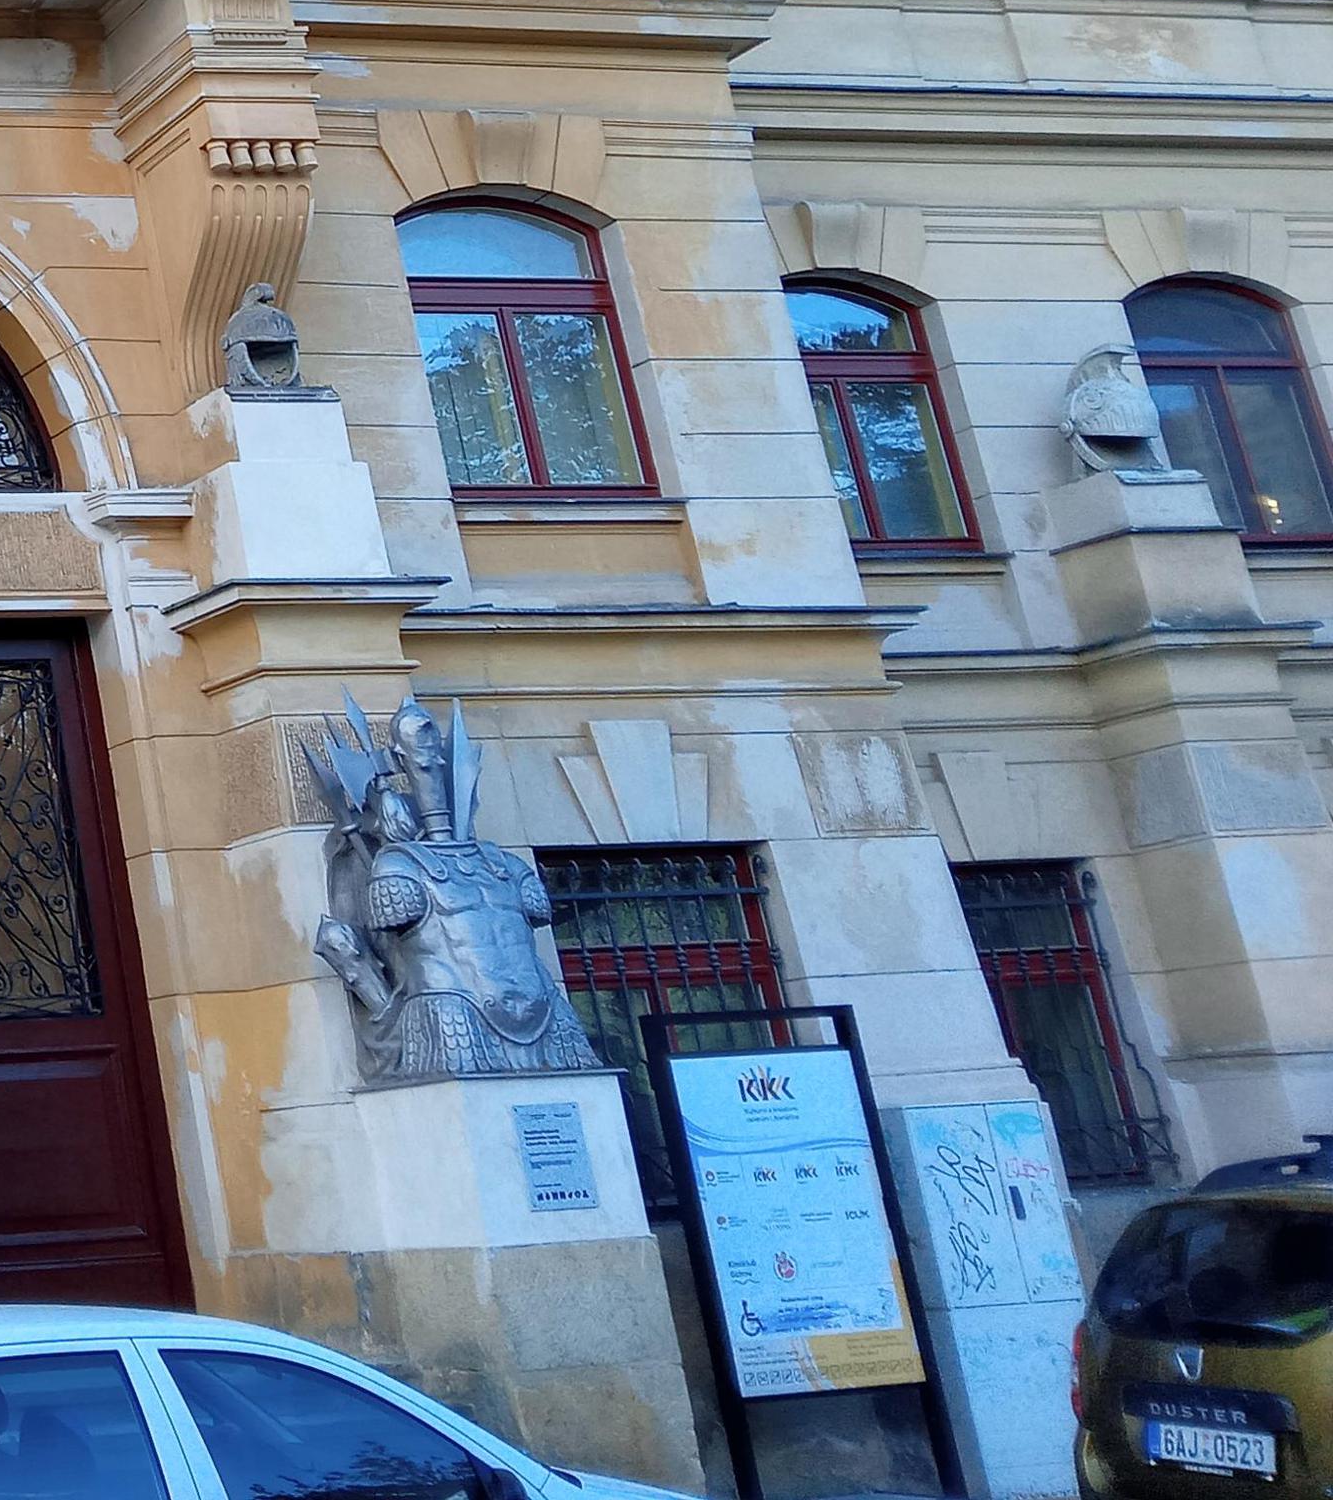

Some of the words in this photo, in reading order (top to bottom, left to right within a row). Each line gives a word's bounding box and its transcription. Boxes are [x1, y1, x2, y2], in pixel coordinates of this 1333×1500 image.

[1149, 1402, 1248, 1425] DUSTER
[1163, 1428, 1199, 1459] 6AJ
[1213, 1433, 1265, 1467] 0523
